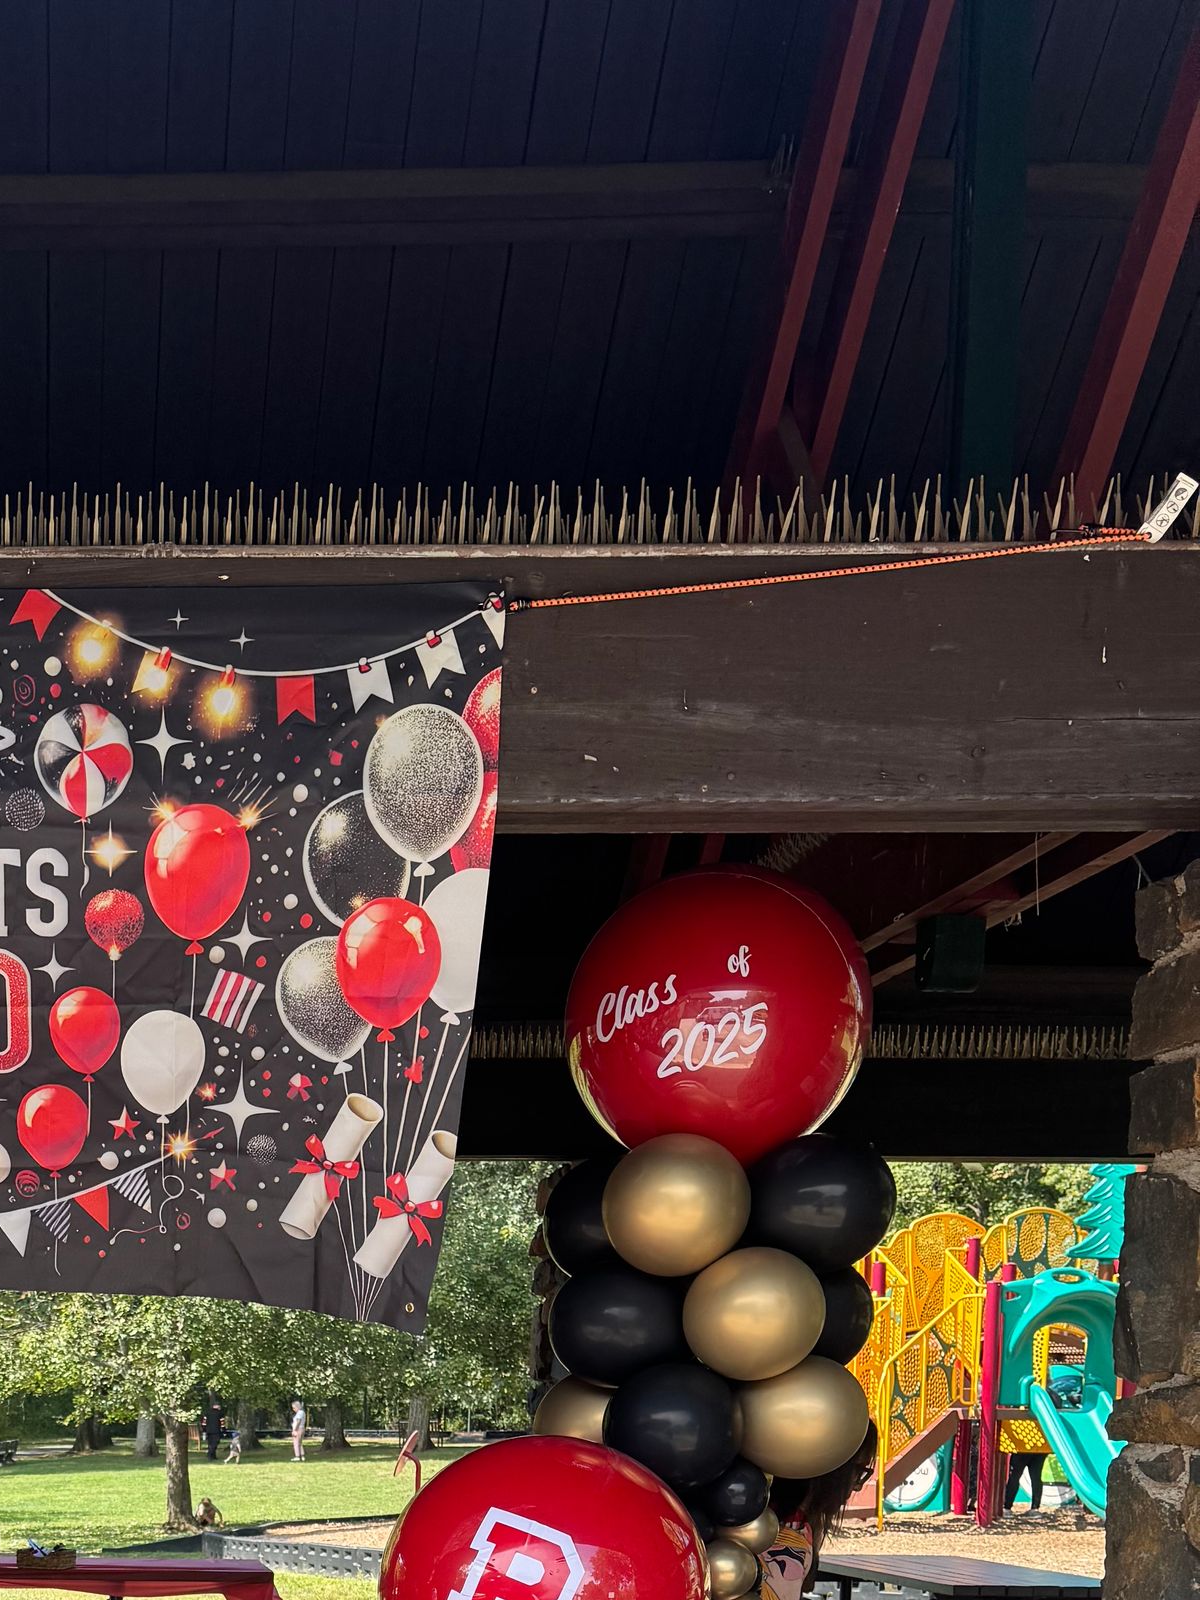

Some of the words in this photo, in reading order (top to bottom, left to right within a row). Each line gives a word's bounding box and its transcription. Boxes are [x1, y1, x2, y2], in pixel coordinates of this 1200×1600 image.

[596, 974, 678, 1043] Class
[727, 945, 752, 978] of
[657, 1002, 769, 1079] 2025
